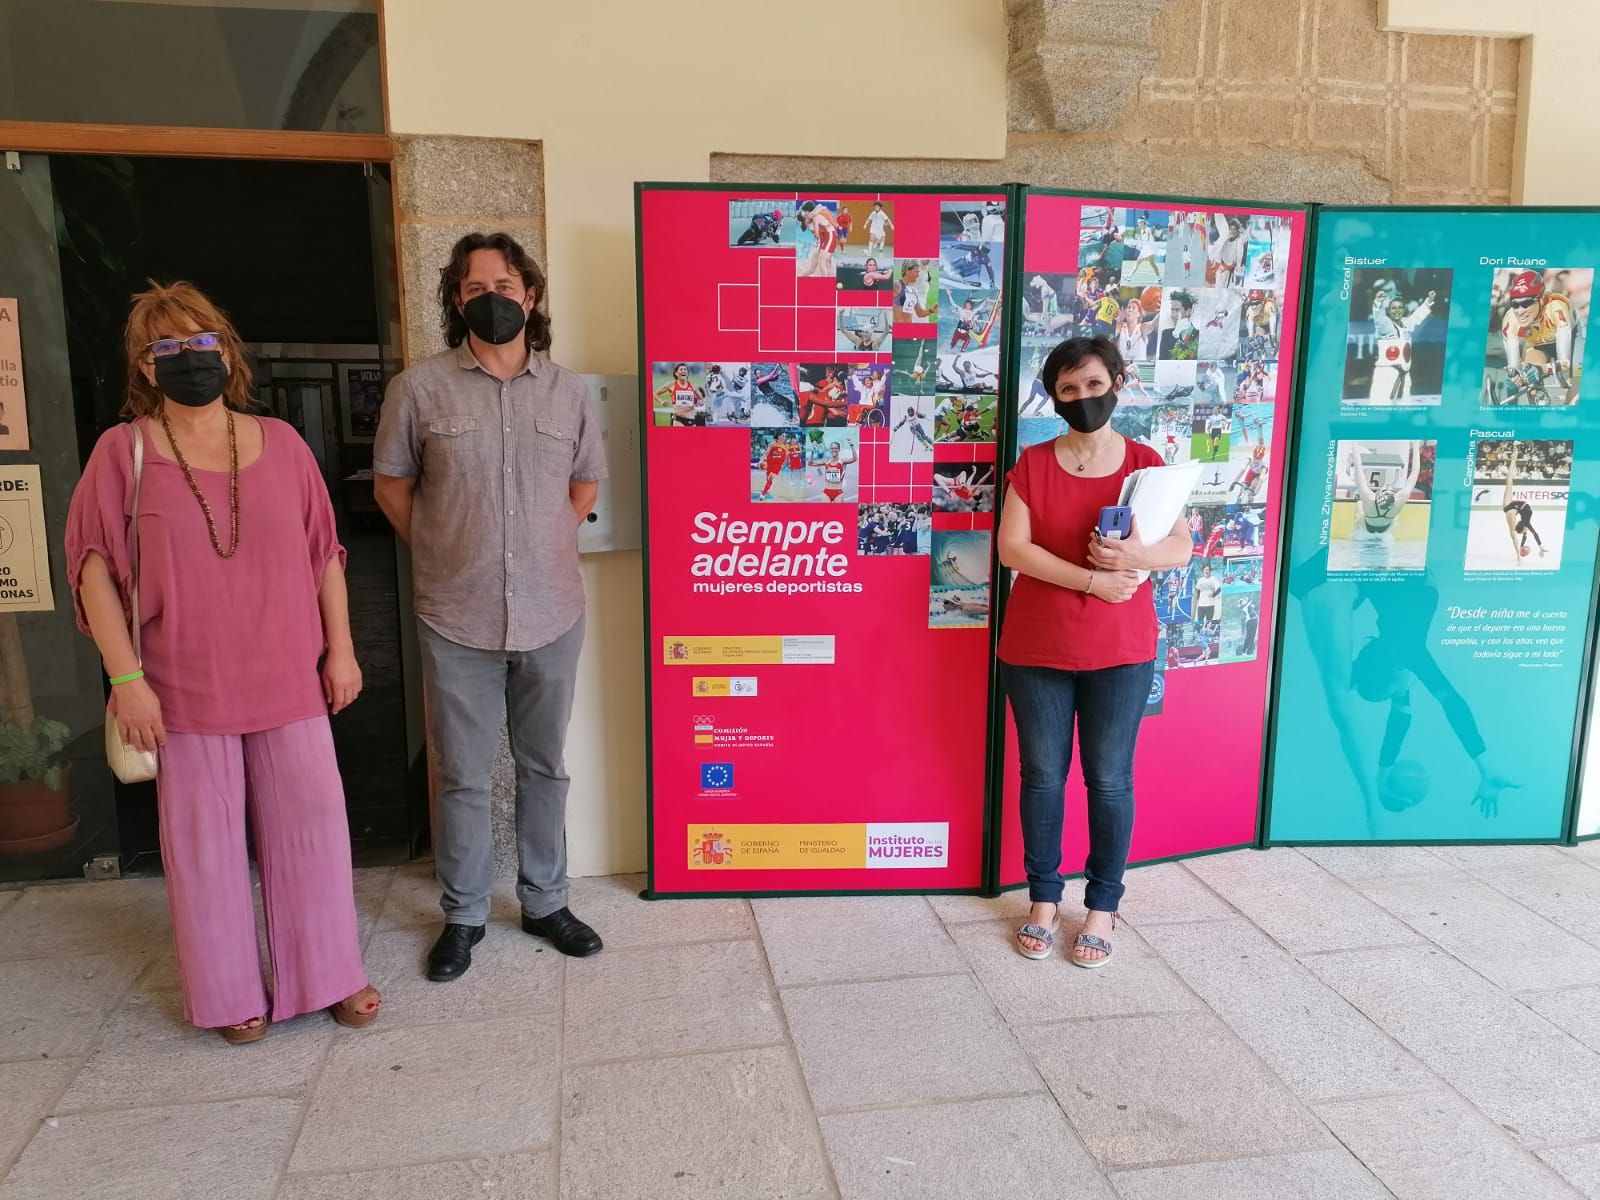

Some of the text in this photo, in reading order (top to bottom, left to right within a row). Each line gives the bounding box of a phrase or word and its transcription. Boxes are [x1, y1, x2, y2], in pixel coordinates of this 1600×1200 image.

[1344, 256, 1388, 266] Bistuer
[1507, 256, 1547, 266] Ruano
[1340, 267, 1351, 301] Coral
[1469, 428, 1515, 438] Pascual
[1463, 440, 1476, 488] Carolina
[0, 479, 29, 492] DE:
[1369, 471, 1381, 488] 5
[1319, 440, 1336, 545] Nina Zhivanevskia
[690, 511, 844, 551] Siempre
[690, 546, 849, 577] adelante
[0, 566, 11, 576] O
[693, 580, 864, 596] mujeres deportistas
[1446, 606, 1488, 620] “Desde
[1490, 607, 1514, 619] niña
[1516, 610, 1531, 619] me
[1541, 610, 1568, 619] cuenta
[1446, 624, 1457, 632] de
[1457, 625, 1472, 634] que
[1482, 624, 1511, 634] deporte
[1542, 623, 1566, 632] buena
[868, 834, 925, 846] Instituto
[752, 846, 780, 854] ESPAÑA
[868, 845, 944, 859] MUJERES
